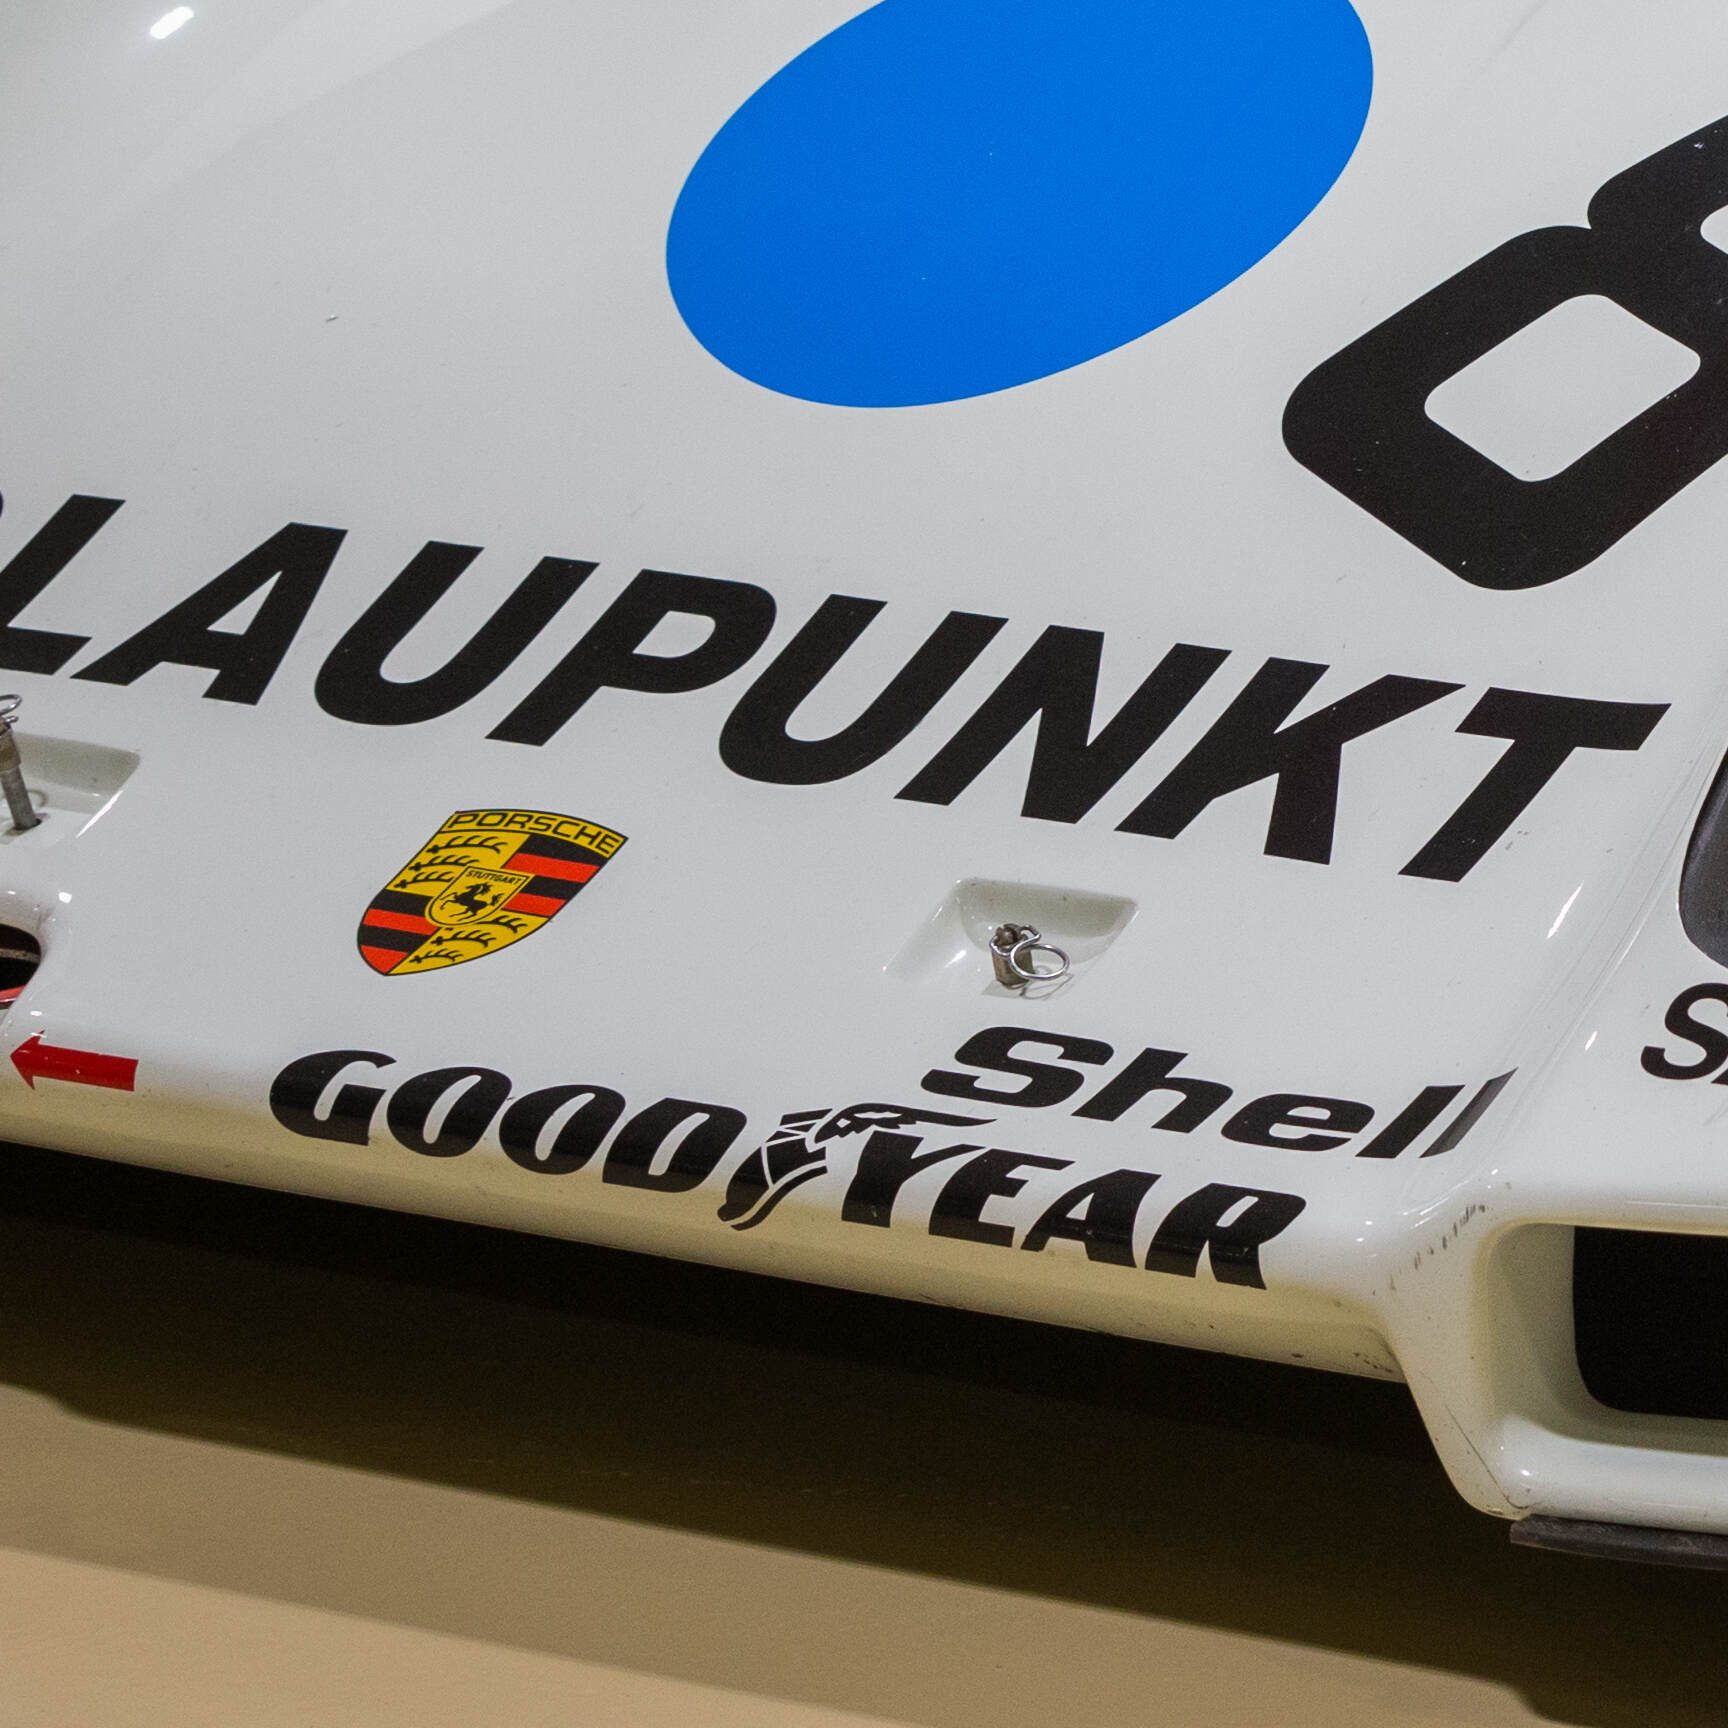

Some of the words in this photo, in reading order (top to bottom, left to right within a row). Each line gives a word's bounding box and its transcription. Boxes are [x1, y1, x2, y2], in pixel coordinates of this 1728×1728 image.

[0, 490, 1673, 884] LAUPUNKT
[446, 811, 621, 857] PORSCHE
[465, 869, 524, 887] STUTTGART
[919, 1024, 1520, 1160] Shell
